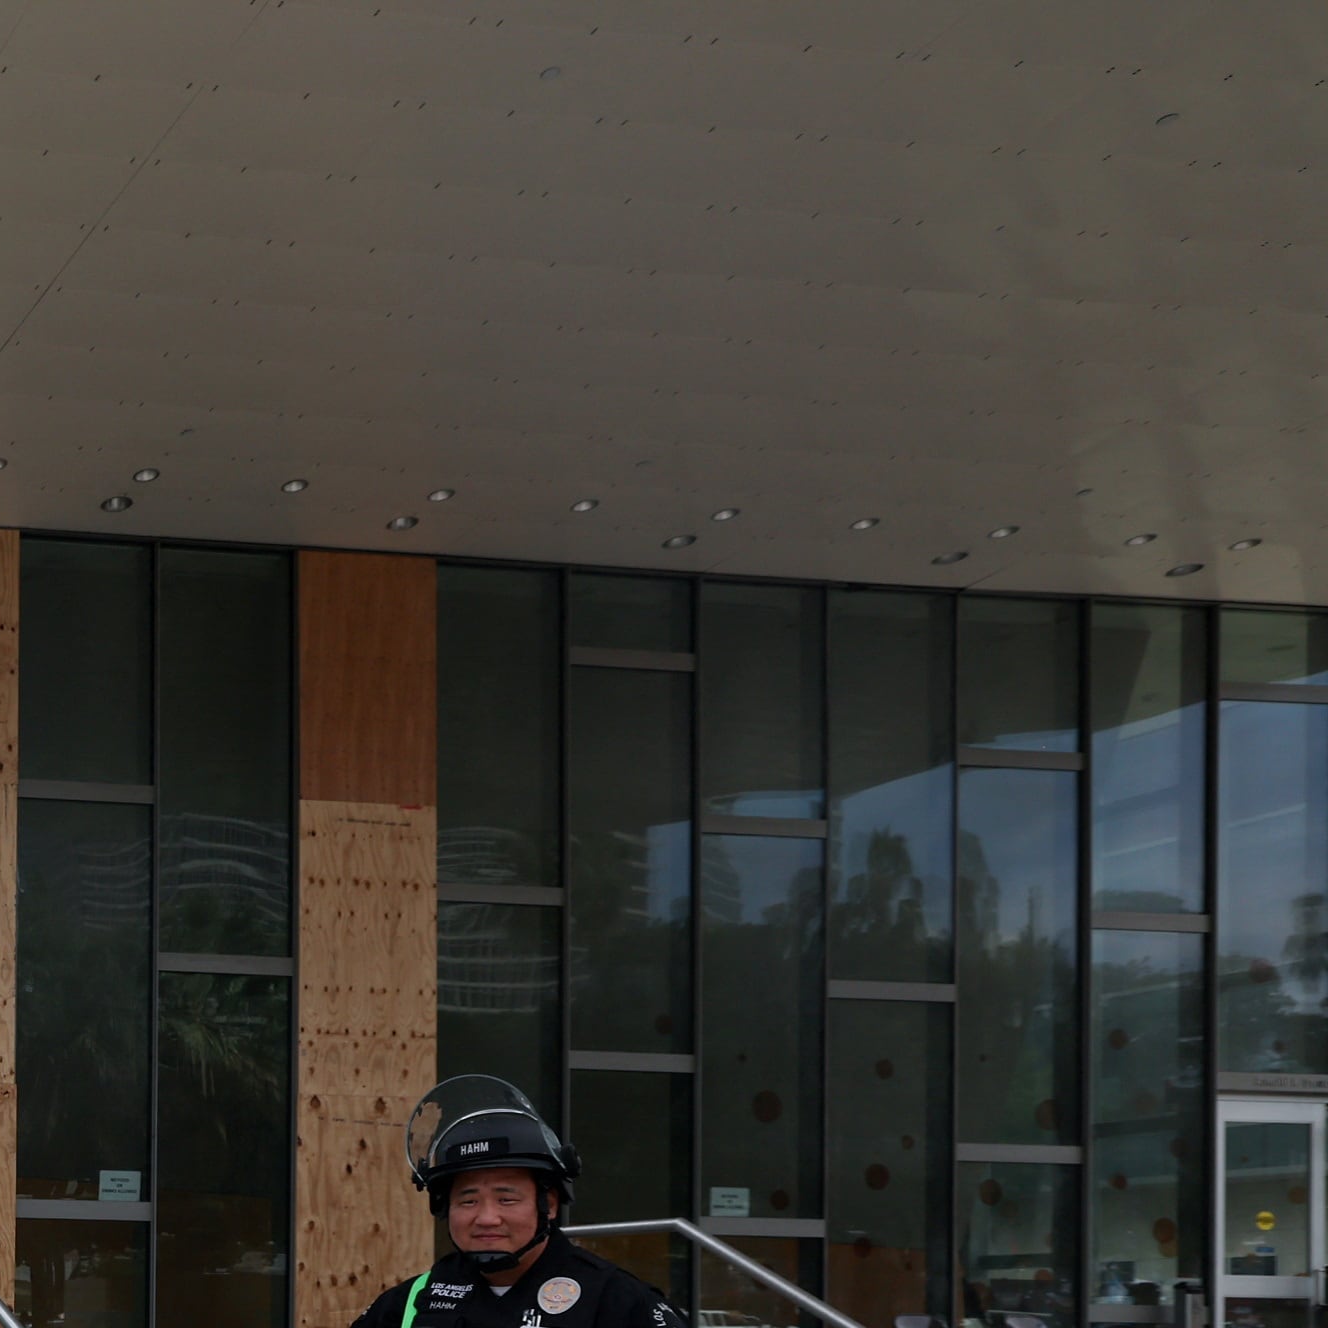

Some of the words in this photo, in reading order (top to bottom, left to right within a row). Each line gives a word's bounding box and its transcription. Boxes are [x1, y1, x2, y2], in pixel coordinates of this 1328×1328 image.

[460, 1141, 489, 1156] HAHM
[431, 1289, 466, 1299] POLICE
[429, 1302, 457, 1310] HAHM
